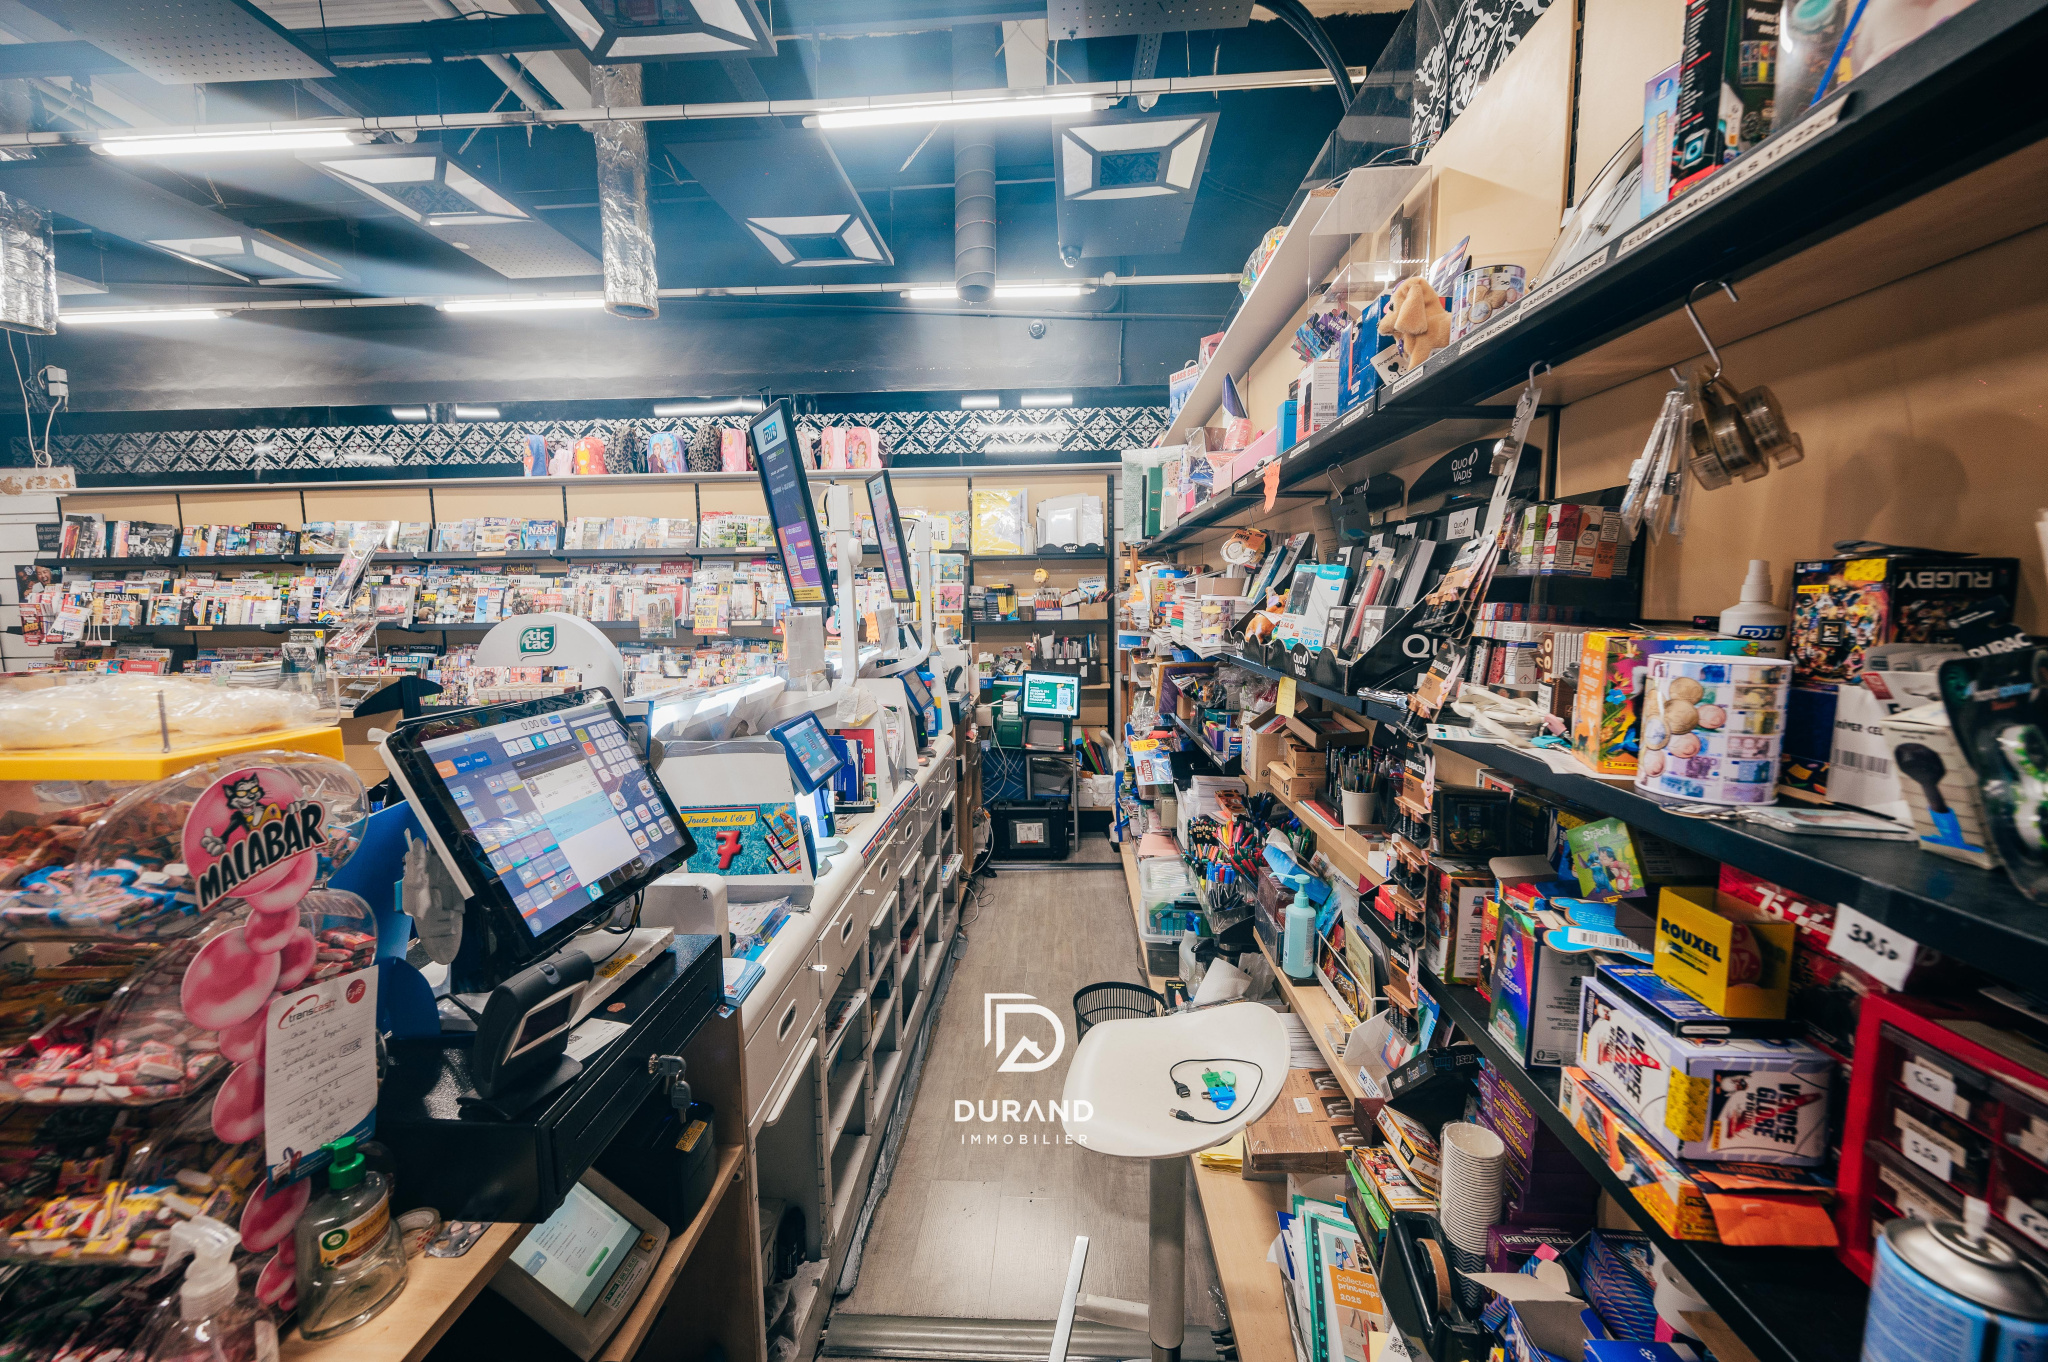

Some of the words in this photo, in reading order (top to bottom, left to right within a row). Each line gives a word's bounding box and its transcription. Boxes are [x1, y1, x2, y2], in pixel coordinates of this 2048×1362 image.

[1621, 209, 1683, 250] FEUILLES
[1686, 161, 1758, 211] MOBILES
[1523, 288, 1554, 310] CAHIER
[1556, 254, 1605, 290] ECRITURE
[1462, 335, 1486, 351] CAHIER
[1487, 314, 1520, 337] MUSIQUE
[1451, 457, 1469, 471] QUO
[1453, 467, 1473, 483] VADIS
[529, 526, 556, 535] NASA
[1898, 571, 1993, 589] RUGBY
[529, 629, 551, 641] tic
[1738, 626, 1771, 640] FDJ
[525, 638, 550, 650] tac
[1405, 759, 1427, 775] DURACELL
[685, 814, 709, 826] Jouez
[711, 816, 728, 824] tout
[730, 813, 747, 824] l'été
[199, 802, 326, 908] MALABAR
[715, 830, 743, 869] 7
[1660, 917, 1723, 963] ROUXEL
[1390, 948, 1410, 967] DURACELL
[289, 999, 337, 1023] transcash
[1754, 1086, 1778, 1137] GLOBE
[1776, 1083, 1801, 1145] VENDÉE
[1501, 1233, 1575, 1246] PREMIUM
[1336, 1274, 1376, 1289] Collection
[1337, 1281, 1380, 1298] printemps
[1339, 1293, 1362, 1305] 2025
